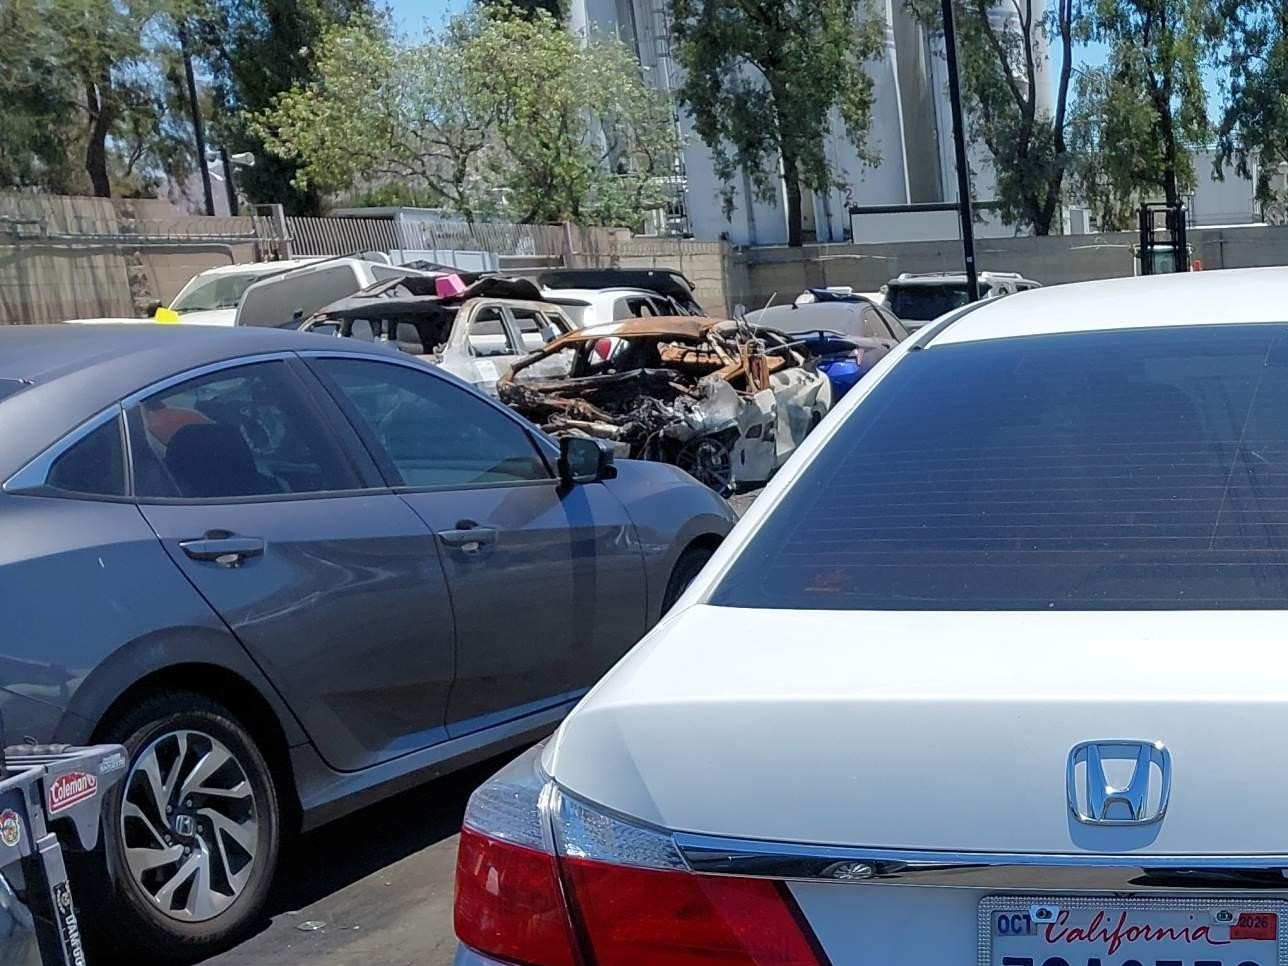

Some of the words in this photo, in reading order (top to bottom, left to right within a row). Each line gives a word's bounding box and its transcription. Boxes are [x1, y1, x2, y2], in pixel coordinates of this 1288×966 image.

[52, 774, 88, 803] Coleman
[997, 914, 1032, 934] OCT
[1044, 910, 1231, 955] California
[1239, 915, 1269, 928] 2026
